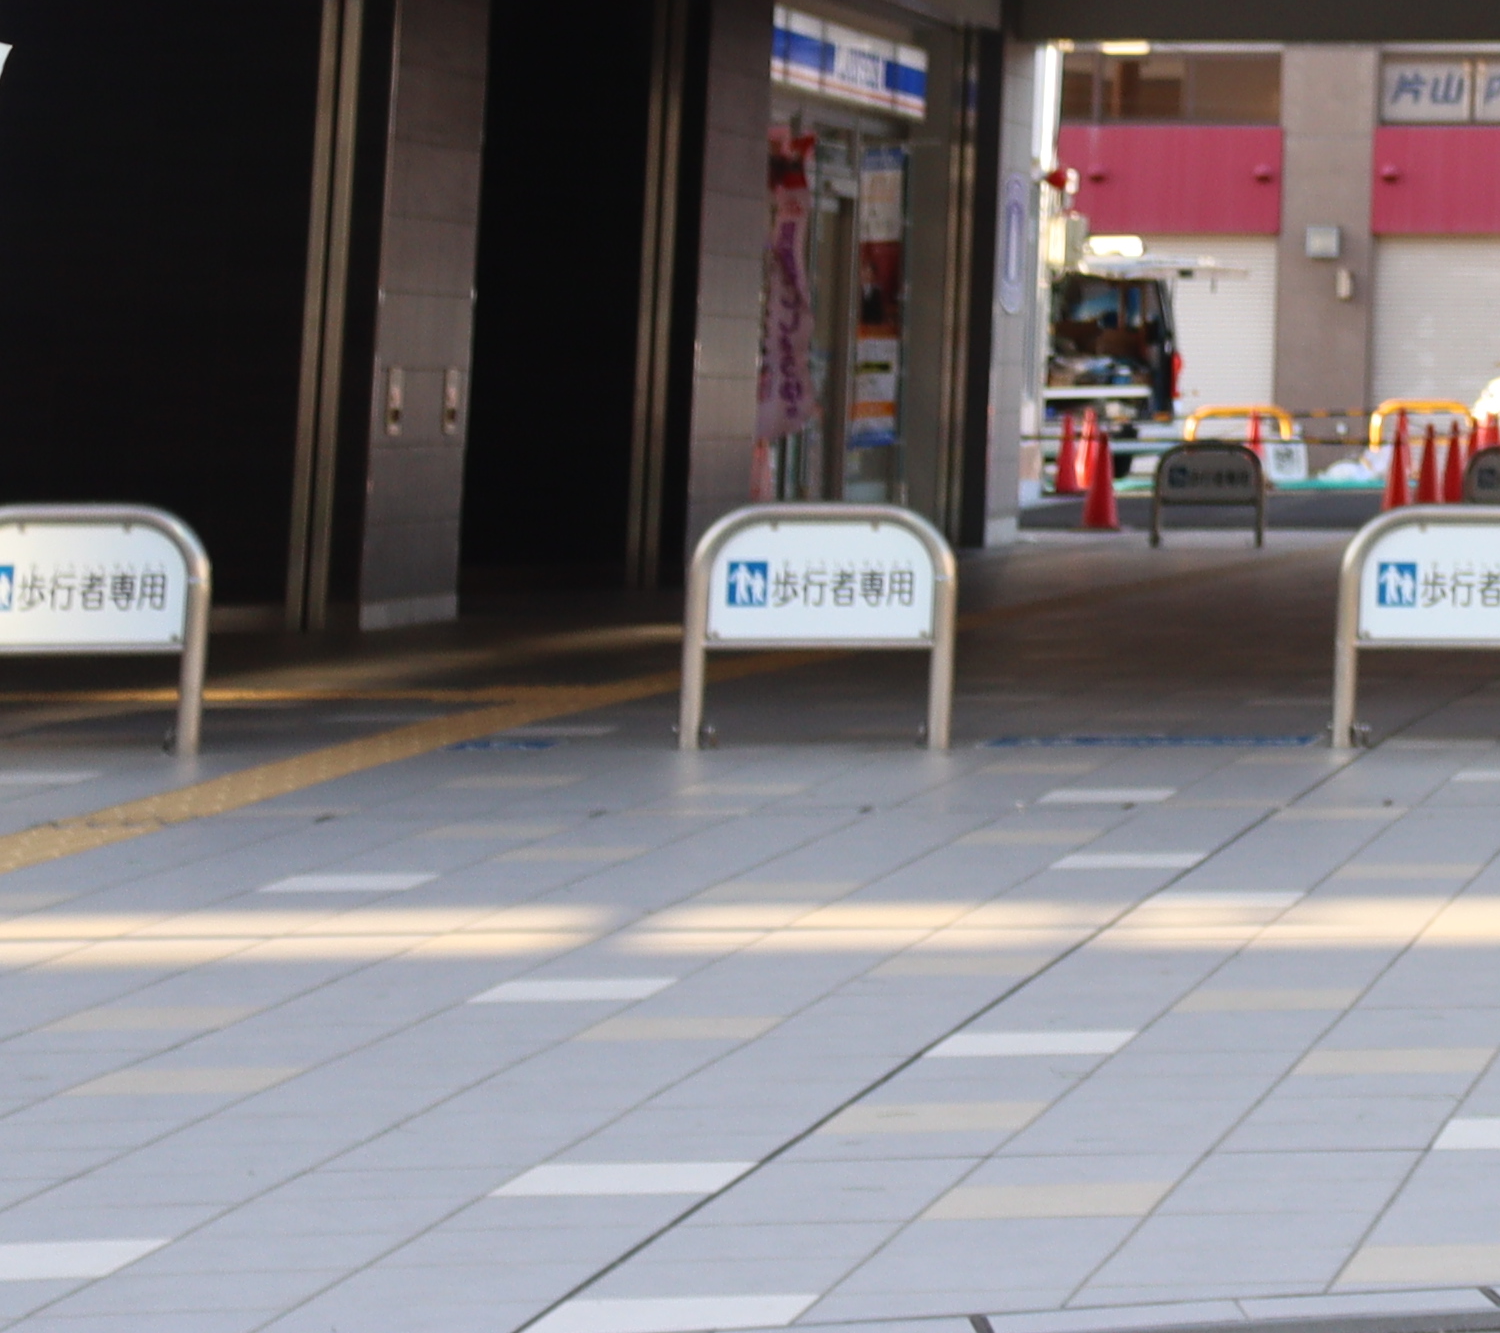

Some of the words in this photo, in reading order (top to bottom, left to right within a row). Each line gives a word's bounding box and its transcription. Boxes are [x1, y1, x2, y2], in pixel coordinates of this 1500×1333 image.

[18, 571, 168, 612] 歩行者専用
[772, 567, 916, 608] 歩行者専用
